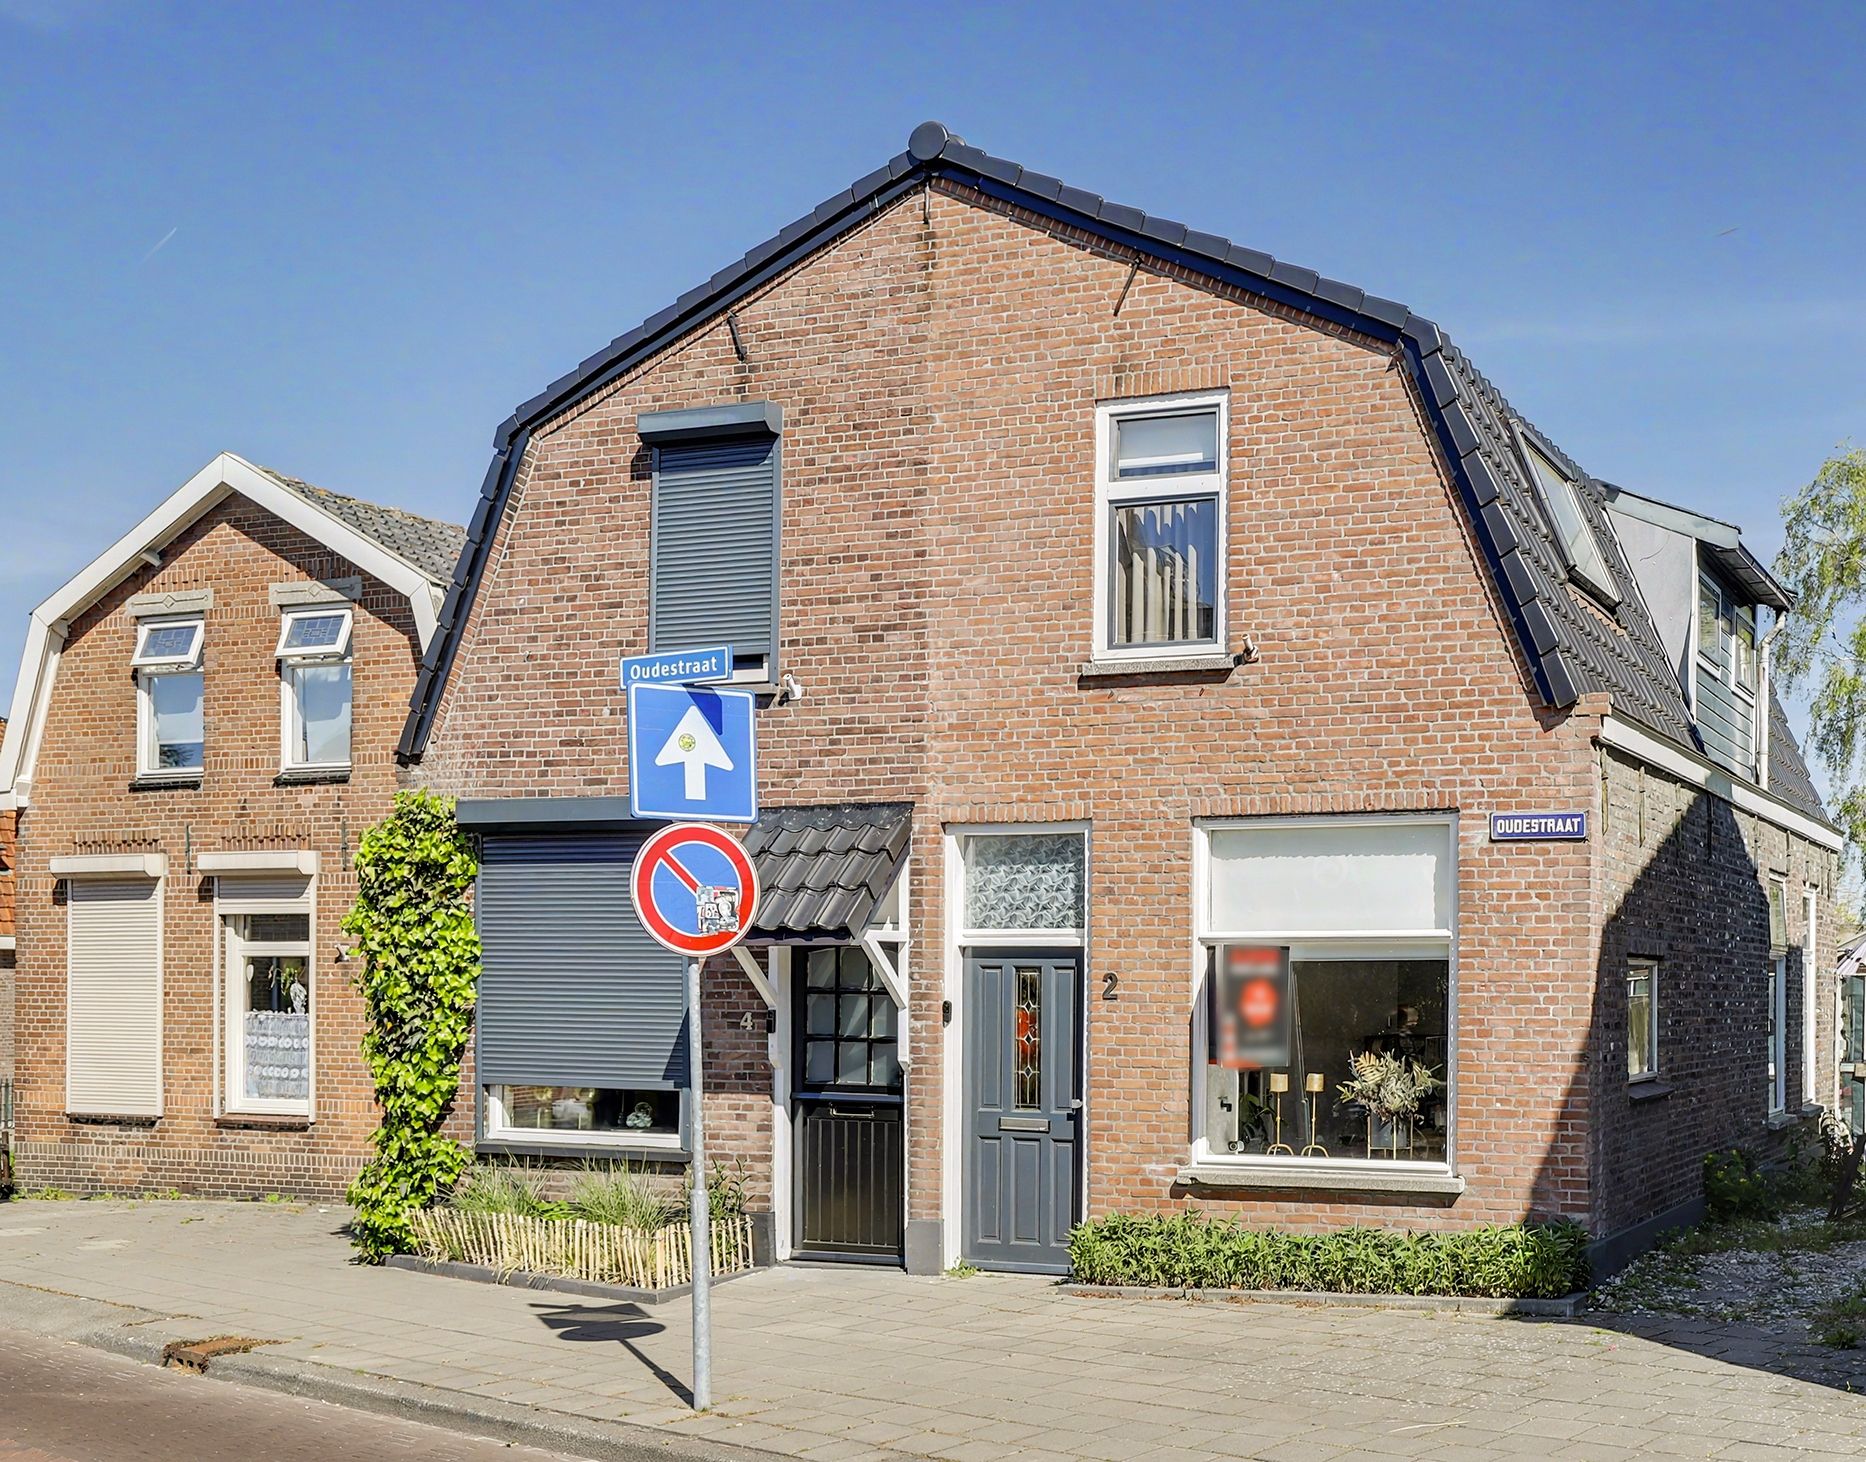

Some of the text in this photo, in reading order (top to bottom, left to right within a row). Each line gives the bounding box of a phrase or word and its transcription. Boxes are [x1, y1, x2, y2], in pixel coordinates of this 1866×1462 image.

[630, 656, 717, 680] Oudestraat
[1496, 817, 1581, 834] OUDESTRAAT
[1102, 972, 1119, 1001] 2
[740, 1011, 754, 1031] 4
